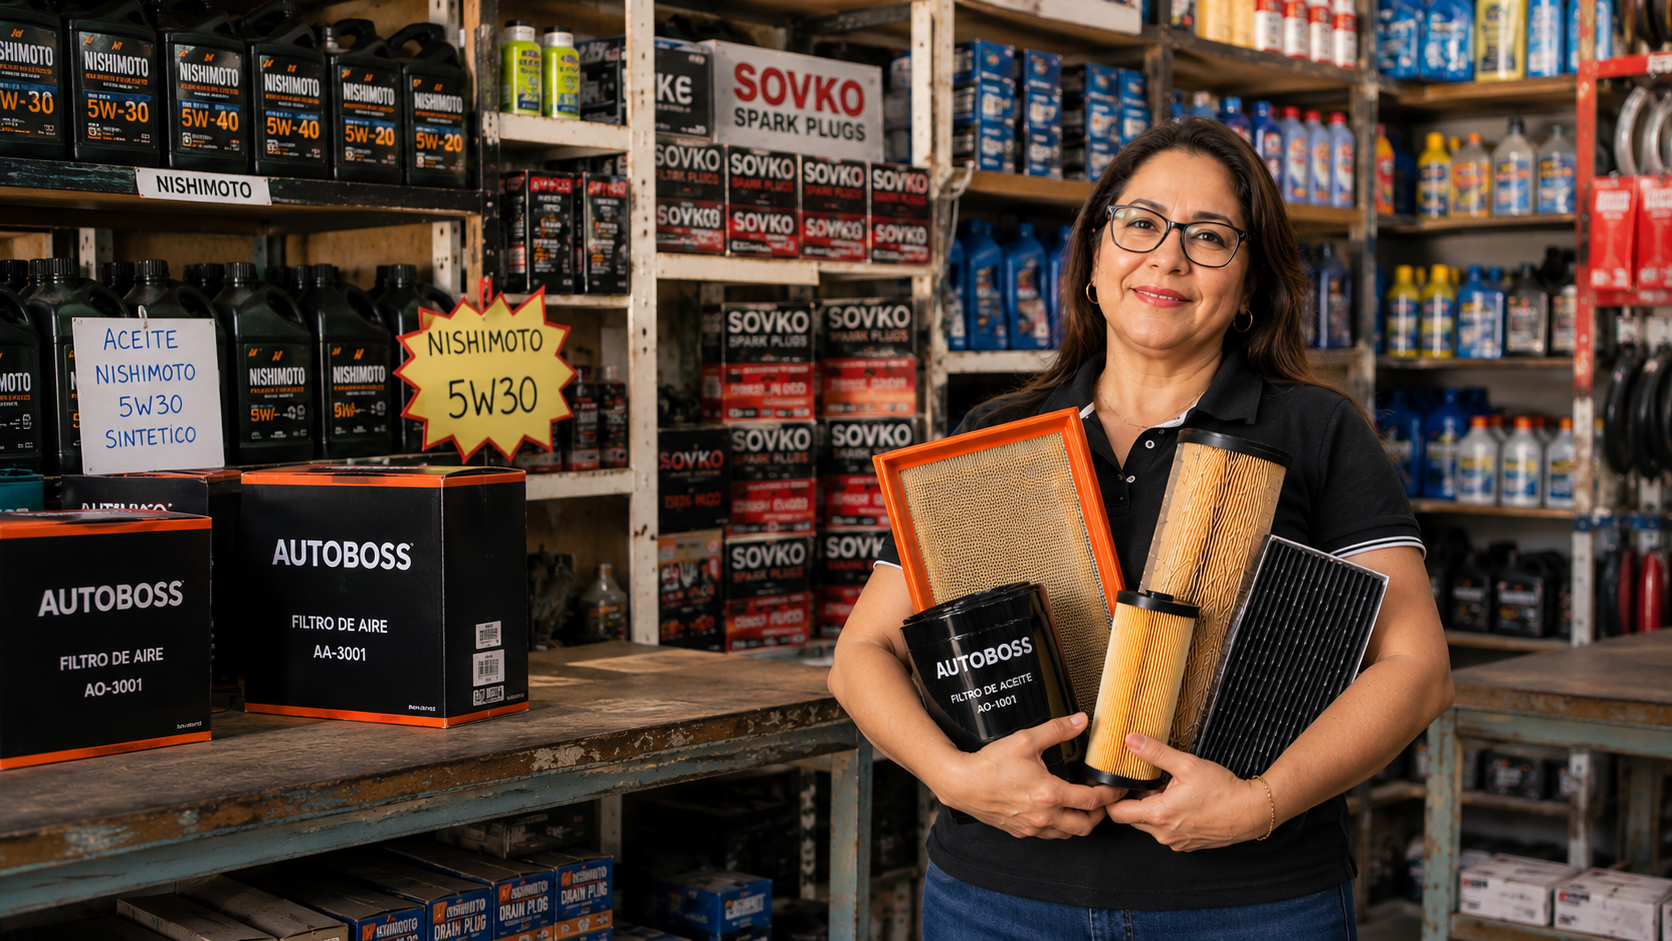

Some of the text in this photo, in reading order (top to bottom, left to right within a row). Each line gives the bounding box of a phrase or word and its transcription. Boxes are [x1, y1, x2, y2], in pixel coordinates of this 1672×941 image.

[85, 51, 149, 77] NISHIMOTO
[180, 62, 239, 87] NISHIMOTO
[264, 73, 320, 97] NISHIMOTO
[343, 82, 395, 107] NISHIMOTO
[734, 61, 866, 117] SOVKO
[88, 99, 149, 123] 5W-30
[414, 92, 463, 114] NISHIMOTO
[182, 107, 239, 132] 5W-40
[266, 117, 320, 139] 5W-40
[734, 107, 867, 142] SPARK PLUGS
[345, 125, 395, 146] 5W-20
[416, 132, 463, 153] 5W-20
[656, 143, 720, 172] SOVKO
[731, 152, 795, 180] SOVKO
[804, 162, 864, 188] SOVKO
[873, 169, 928, 194] SOVKO
[156, 174, 252, 202] NISHIMOTO
[733, 211, 794, 235] SOVKO
[728, 310, 810, 334] SOVKO
[828, 304, 911, 330] SOVKO
[103, 327, 179, 351] ACEITE
[427, 328, 544, 357] NISHIMOTO
[728, 335, 808, 348] SPARK PLUGS
[96, 362, 196, 386] NISHIMOTO
[249, 367, 306, 386] NISHIMOTO
[333, 365, 386, 384] NISHIMOTO
[119, 394, 183, 418] 5W30
[448, 375, 538, 420] 5W30
[732, 428, 811, 452] SOVKO
[832, 423, 913, 448] SOVKO
[659, 450, 724, 471] SOVKO
[272, 539, 412, 571] AUTOBOSS
[732, 543, 806, 569] SOVKO
[826, 536, 886, 559] SOVK
[38, 579, 184, 618] AUTOBOSS
[292, 615, 388, 634] FILTRO DE AIRE
[60, 647, 164, 671] FILTRO DE AIRE
[313, 644, 367, 662] AA-3001
[936, 636, 1033, 680] AUTOBOSS
[84, 677, 143, 698] AO-3001
[950, 672, 1034, 704] FILTRO DE ACEITE
[977, 694, 1017, 714] AO-1001
[464, 914, 487, 934] PLUG
